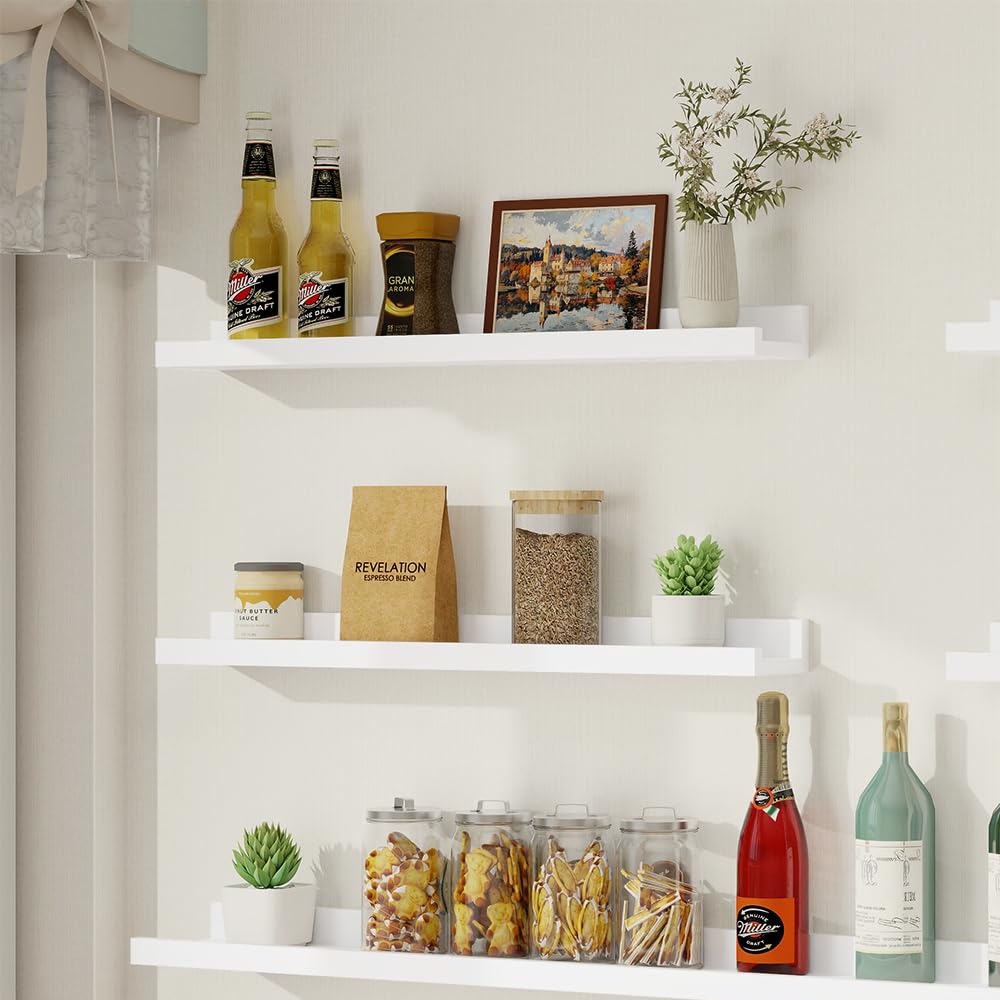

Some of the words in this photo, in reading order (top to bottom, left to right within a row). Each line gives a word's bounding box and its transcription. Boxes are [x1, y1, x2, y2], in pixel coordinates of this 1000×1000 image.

[228, 274, 264, 297] Miller
[388, 276, 415, 285] GRAN
[245, 302, 275, 315] DRAFT
[314, 306, 341, 316] DRAFT
[354, 561, 427, 574] REVELATION
[363, 574, 395, 582] ESPRESSO
[737, 920, 781, 937] Miller
